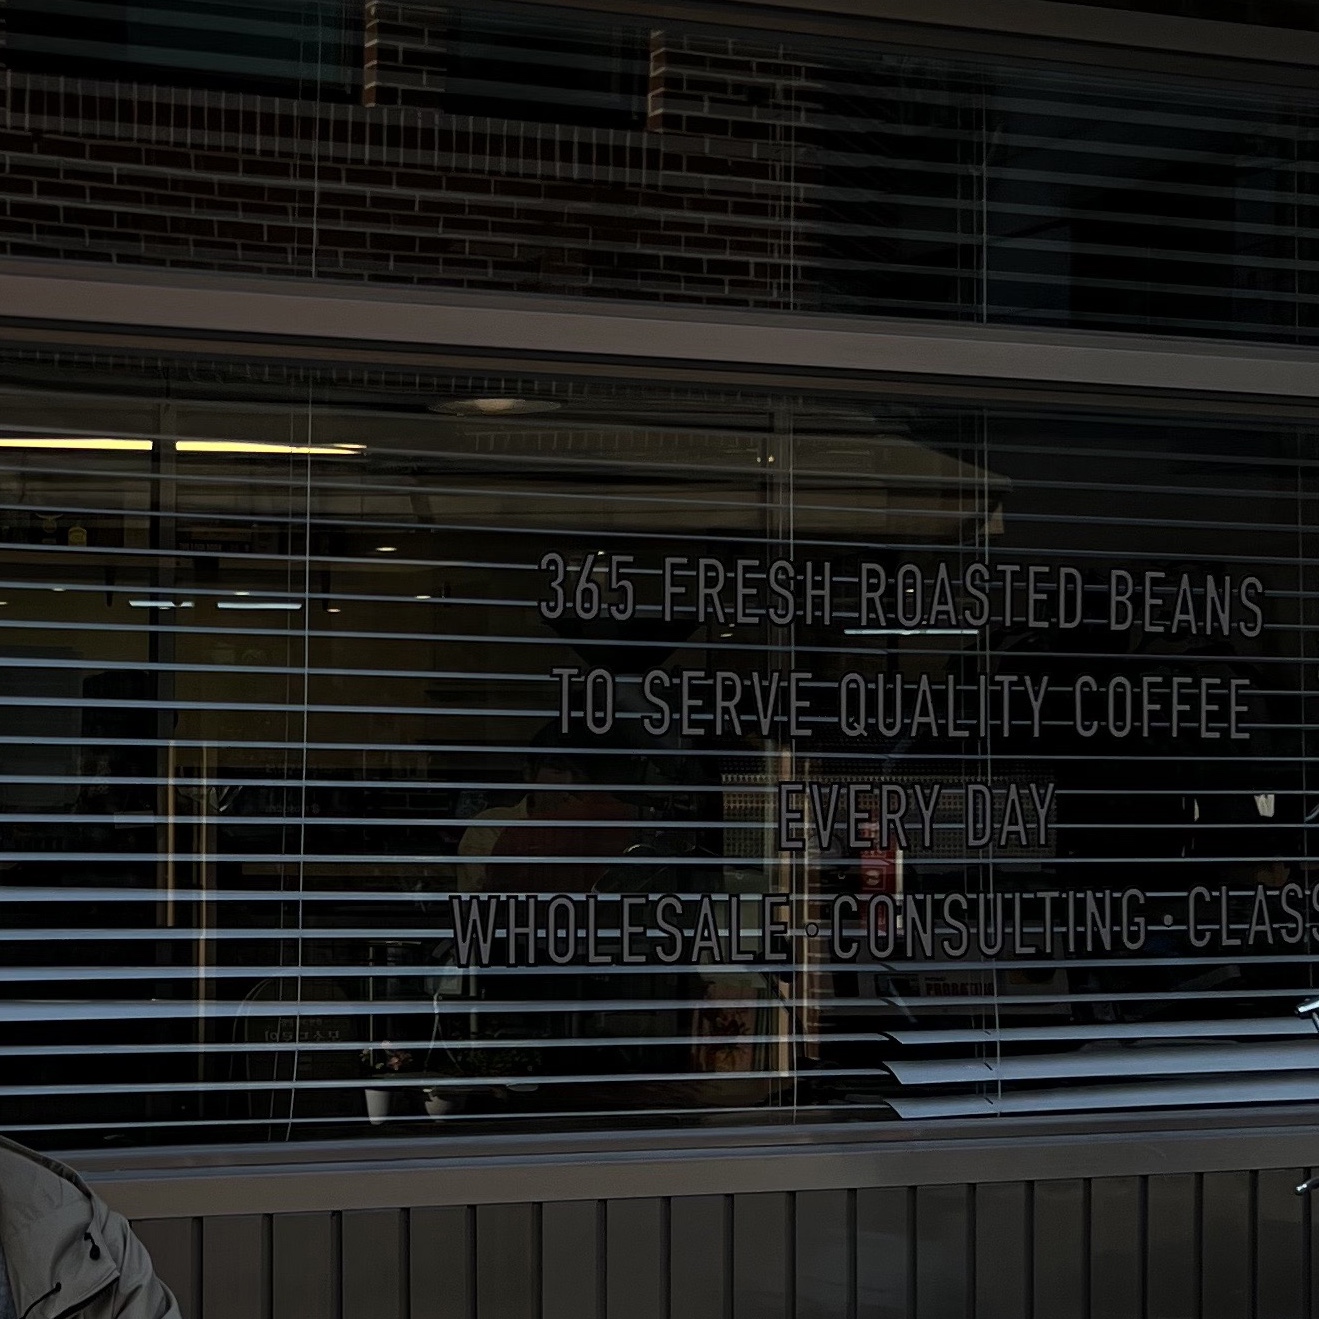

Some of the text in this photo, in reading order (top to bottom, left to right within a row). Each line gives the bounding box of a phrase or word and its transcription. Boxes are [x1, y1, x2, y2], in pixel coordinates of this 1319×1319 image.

[539, 551, 1264, 638] 365 FRESH ROASTED BEANS
[552, 667, 1251, 740] TO SERVE QUALITY COFFEE
[780, 782, 1055, 848] EVERY DAY
[452, 895, 788, 966] WHOLESALE
[833, 888, 1146, 960] CONSULTING
